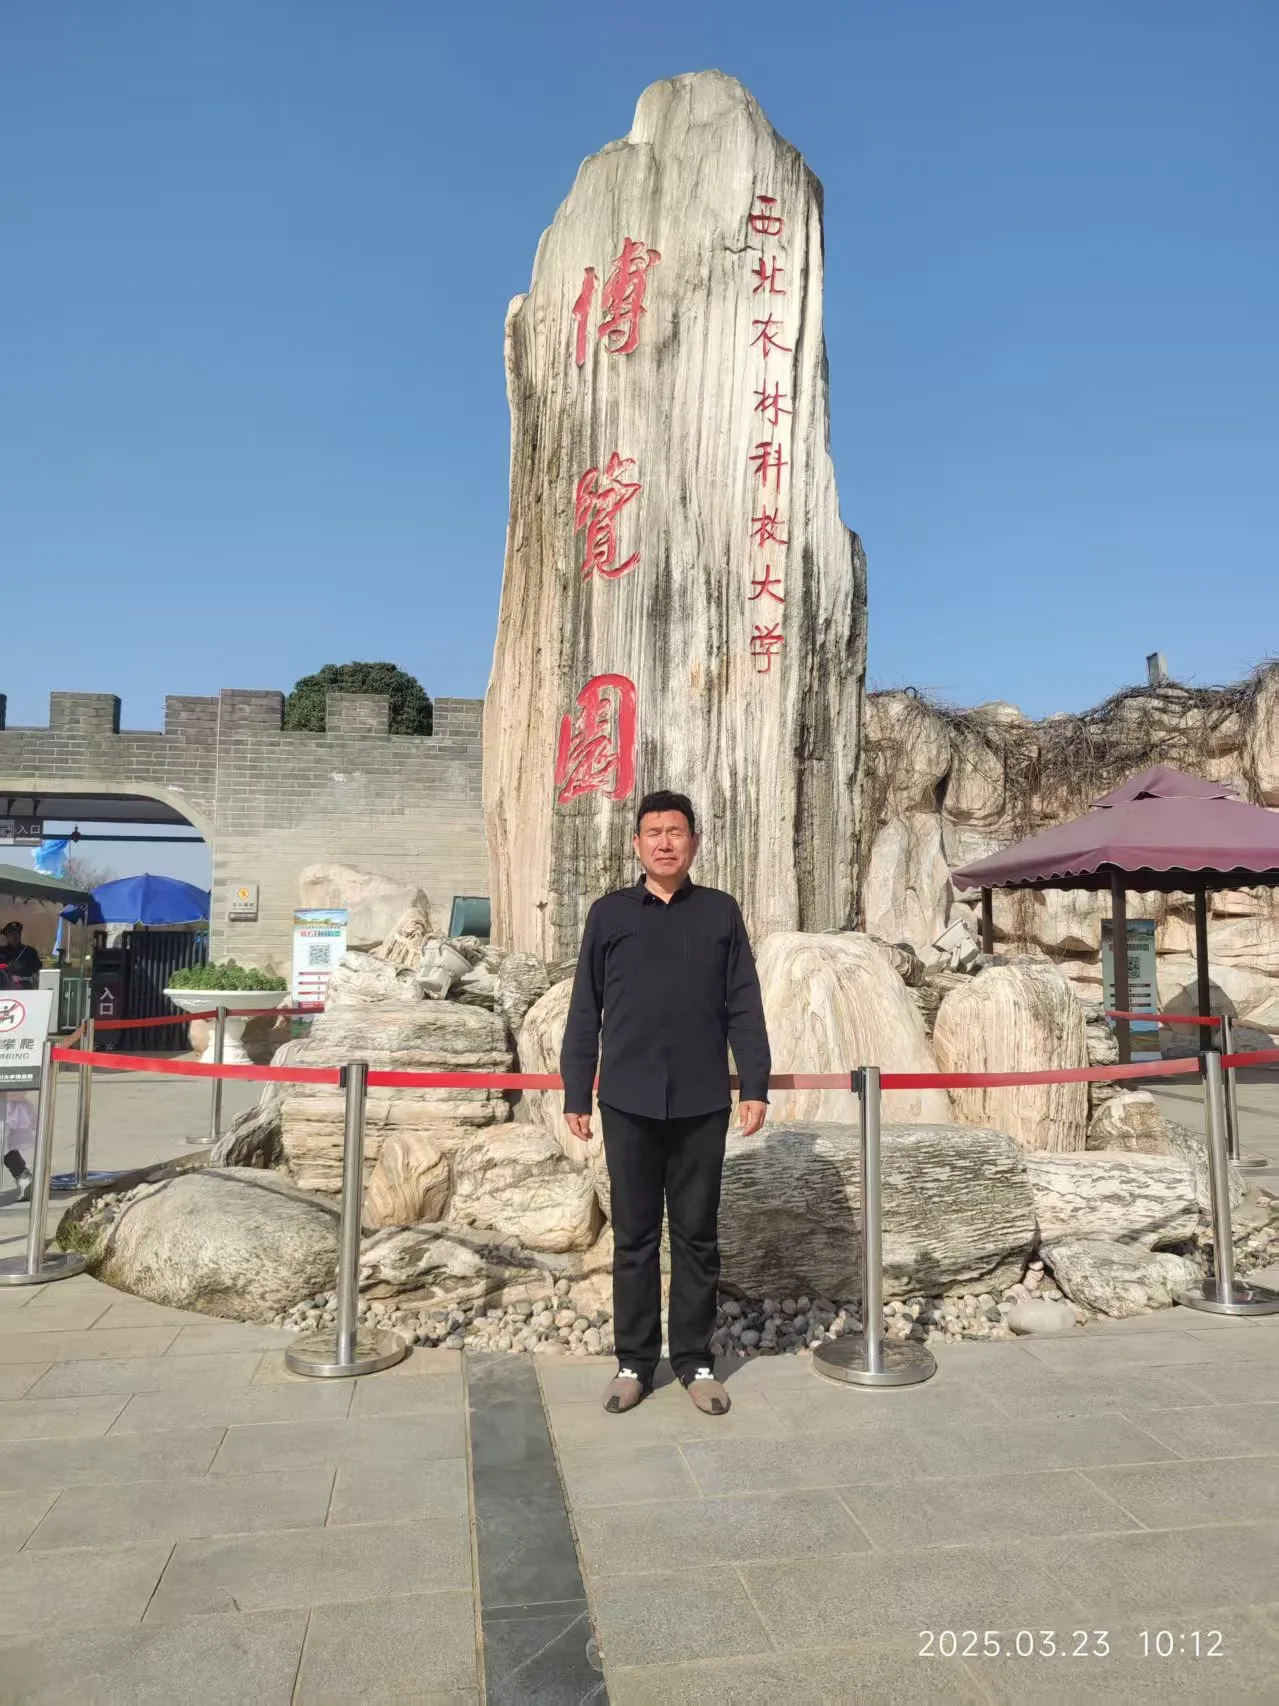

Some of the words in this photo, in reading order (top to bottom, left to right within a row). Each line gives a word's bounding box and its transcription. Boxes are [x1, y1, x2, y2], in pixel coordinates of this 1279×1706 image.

[749, 194, 793, 676] 西北农林科技大学
[17, 824, 40, 834] 入口
[99, 986, 115, 1016] 入口
